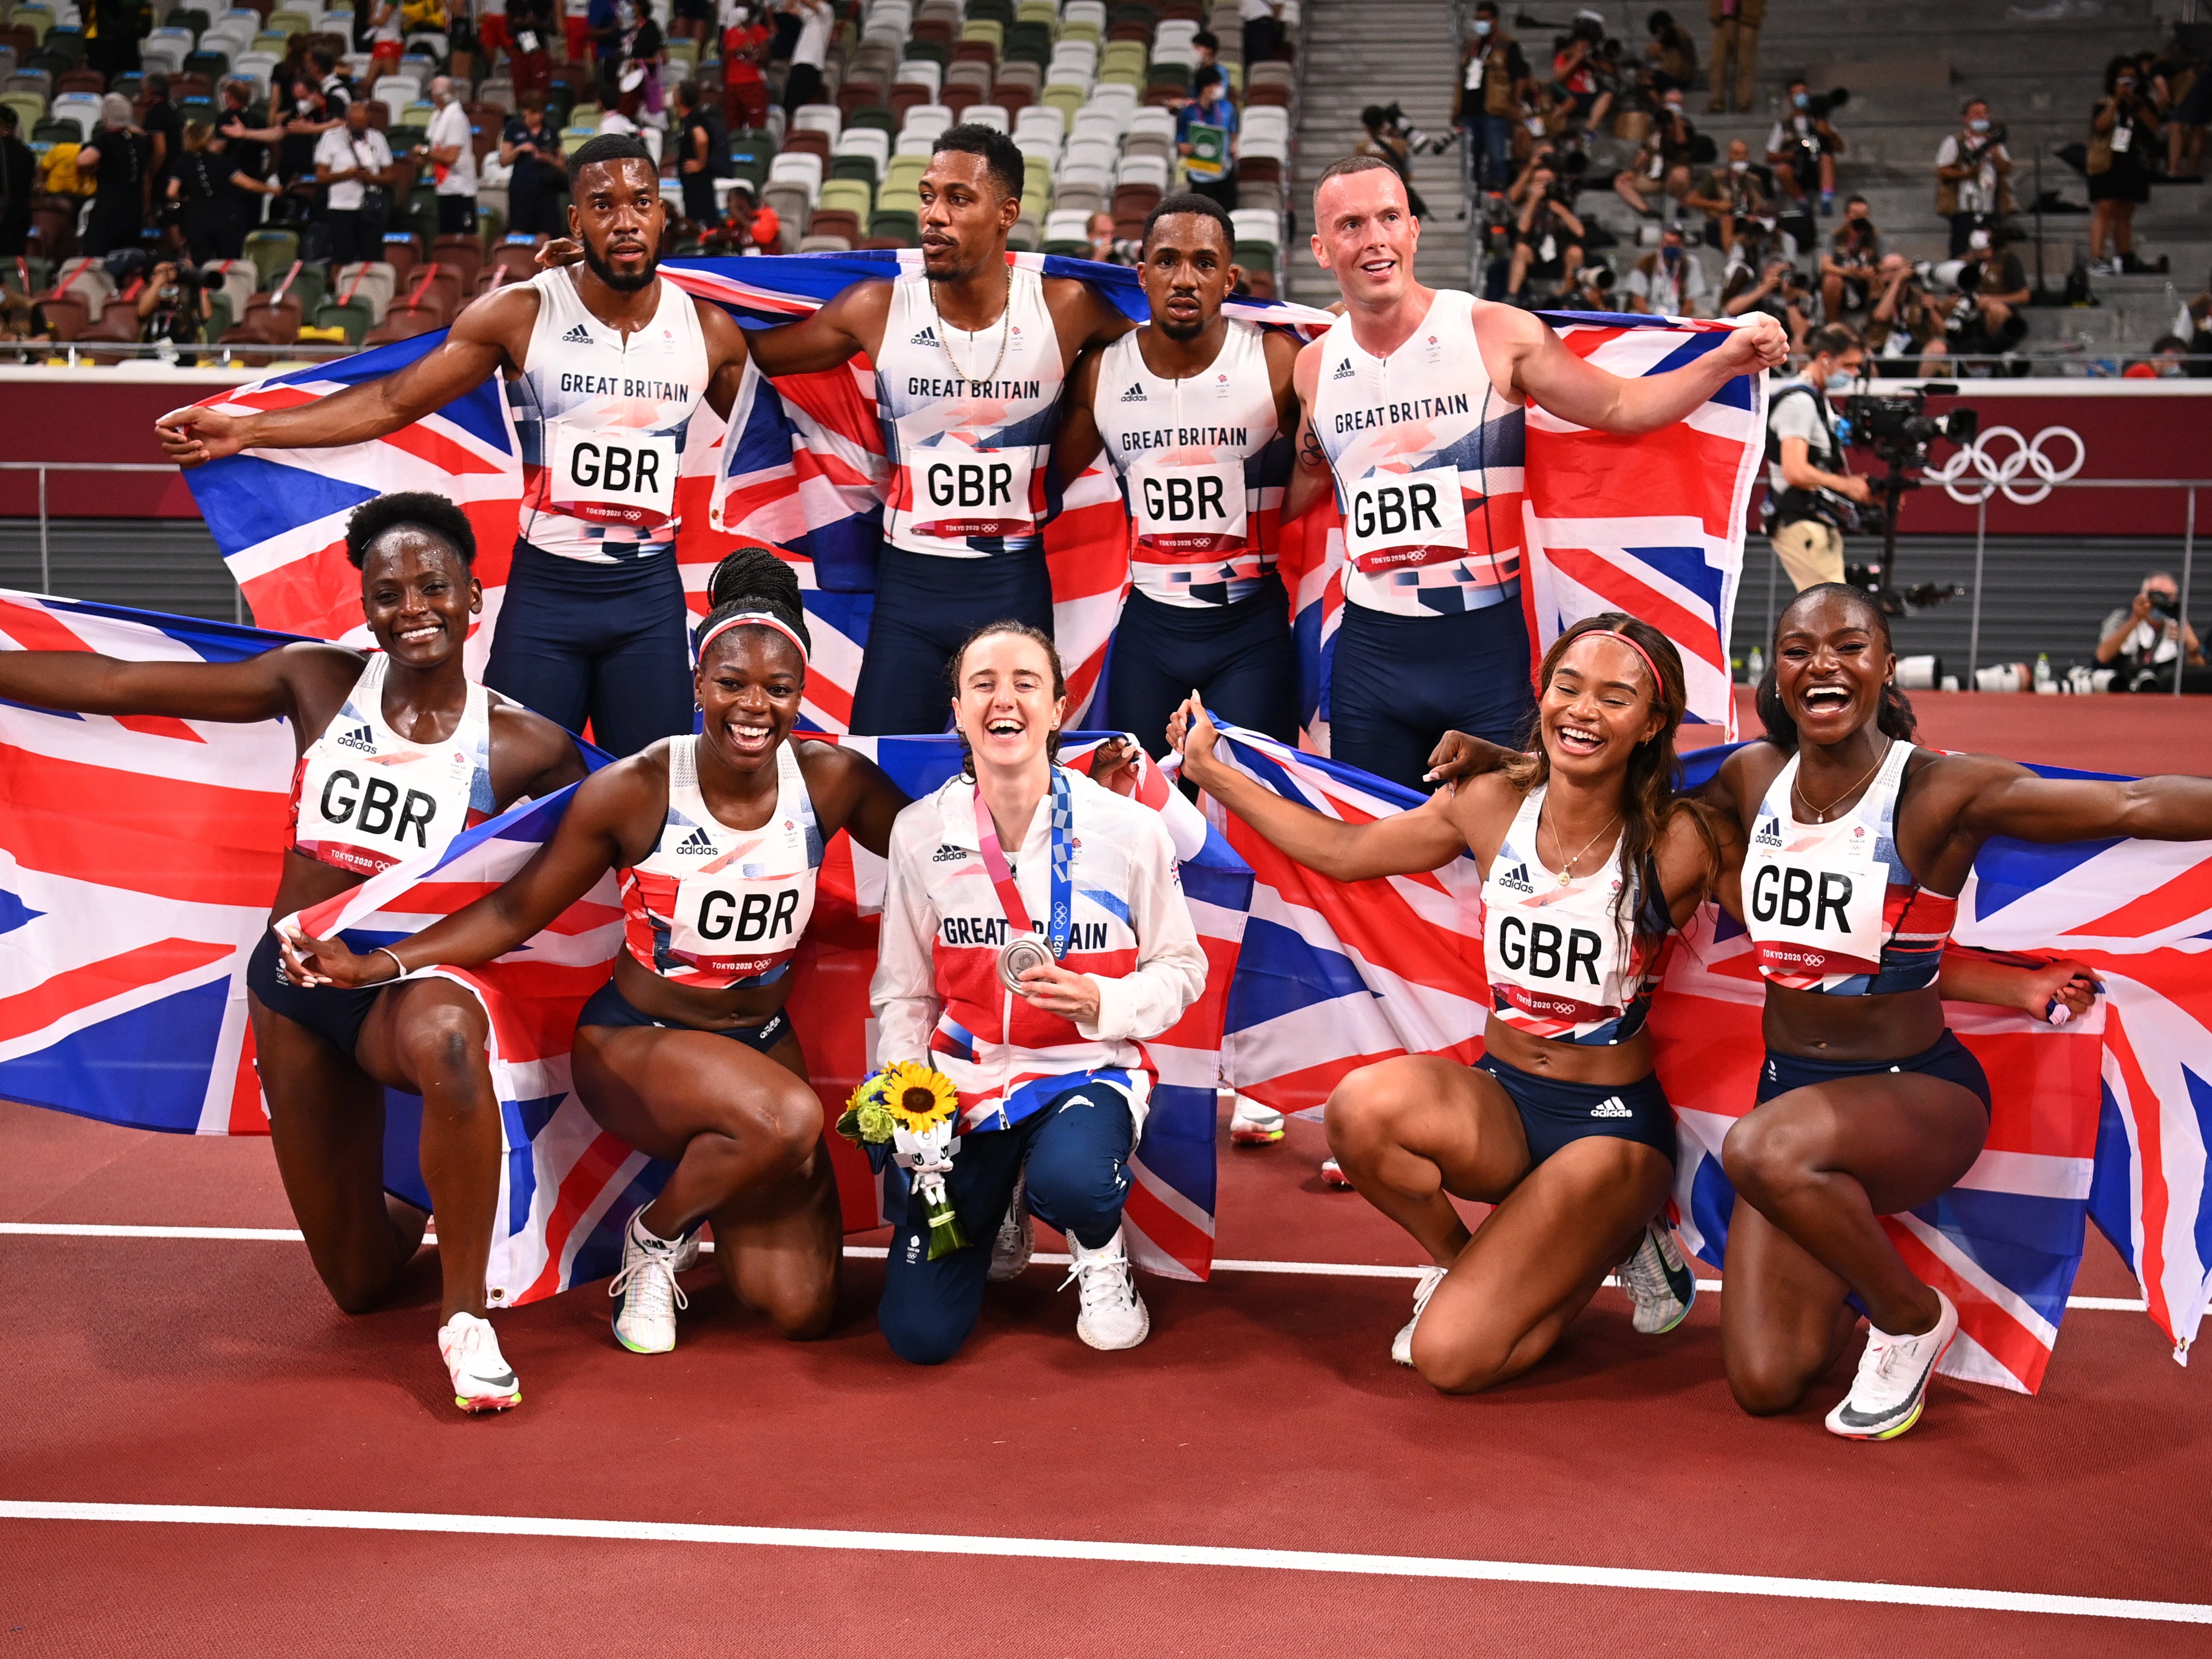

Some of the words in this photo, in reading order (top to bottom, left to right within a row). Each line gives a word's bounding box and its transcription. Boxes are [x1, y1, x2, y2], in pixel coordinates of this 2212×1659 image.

[563, 334, 594, 344] adidas
[911, 338, 940, 347] adidas
[1333, 370, 1355, 380] adidas
[561, 373, 618, 395] GREAT
[624, 379, 688, 403] BRITAIN
[909, 377, 966, 398] GREAT
[971, 380, 1039, 399] BRITAIN
[1335, 407, 1385, 434] GREAT
[1390, 394, 1469, 424] BRITAIN
[1122, 429, 1173, 451] GREAT
[1179, 427, 1247, 446] BRITAIN
[571, 442, 659, 493] GBR
[928, 463, 1012, 507] GBR
[1143, 476, 1227, 521] GBR
[586, 507, 606, 516] TOKYO
[1354, 483, 1442, 538] GBR
[1371, 556, 1391, 565] TOKYO
[337, 737, 377, 754] adidas
[320, 770, 437, 849] GBR
[1755, 832, 1782, 847] adidas
[332, 849, 353, 862] TOKYO
[354, 857, 373, 867] 2020
[676, 845, 718, 855] adidas
[932, 850, 967, 862] adidas
[1500, 876, 1534, 894] adidas
[1752, 865, 1853, 933] GBR
[697, 889, 799, 941] GBR
[944, 917, 1009, 946] GREAT
[1500, 916, 1602, 985] GBR
[1763, 949, 1783, 960] TOKYO
[1784, 951, 1801, 962] 2020
[712, 962, 735, 970] TOKYO
[1516, 993, 1532, 1006] TOKYO
[1532, 1000, 1551, 1009] 2020
[1591, 1108, 1632, 1117] adidas
